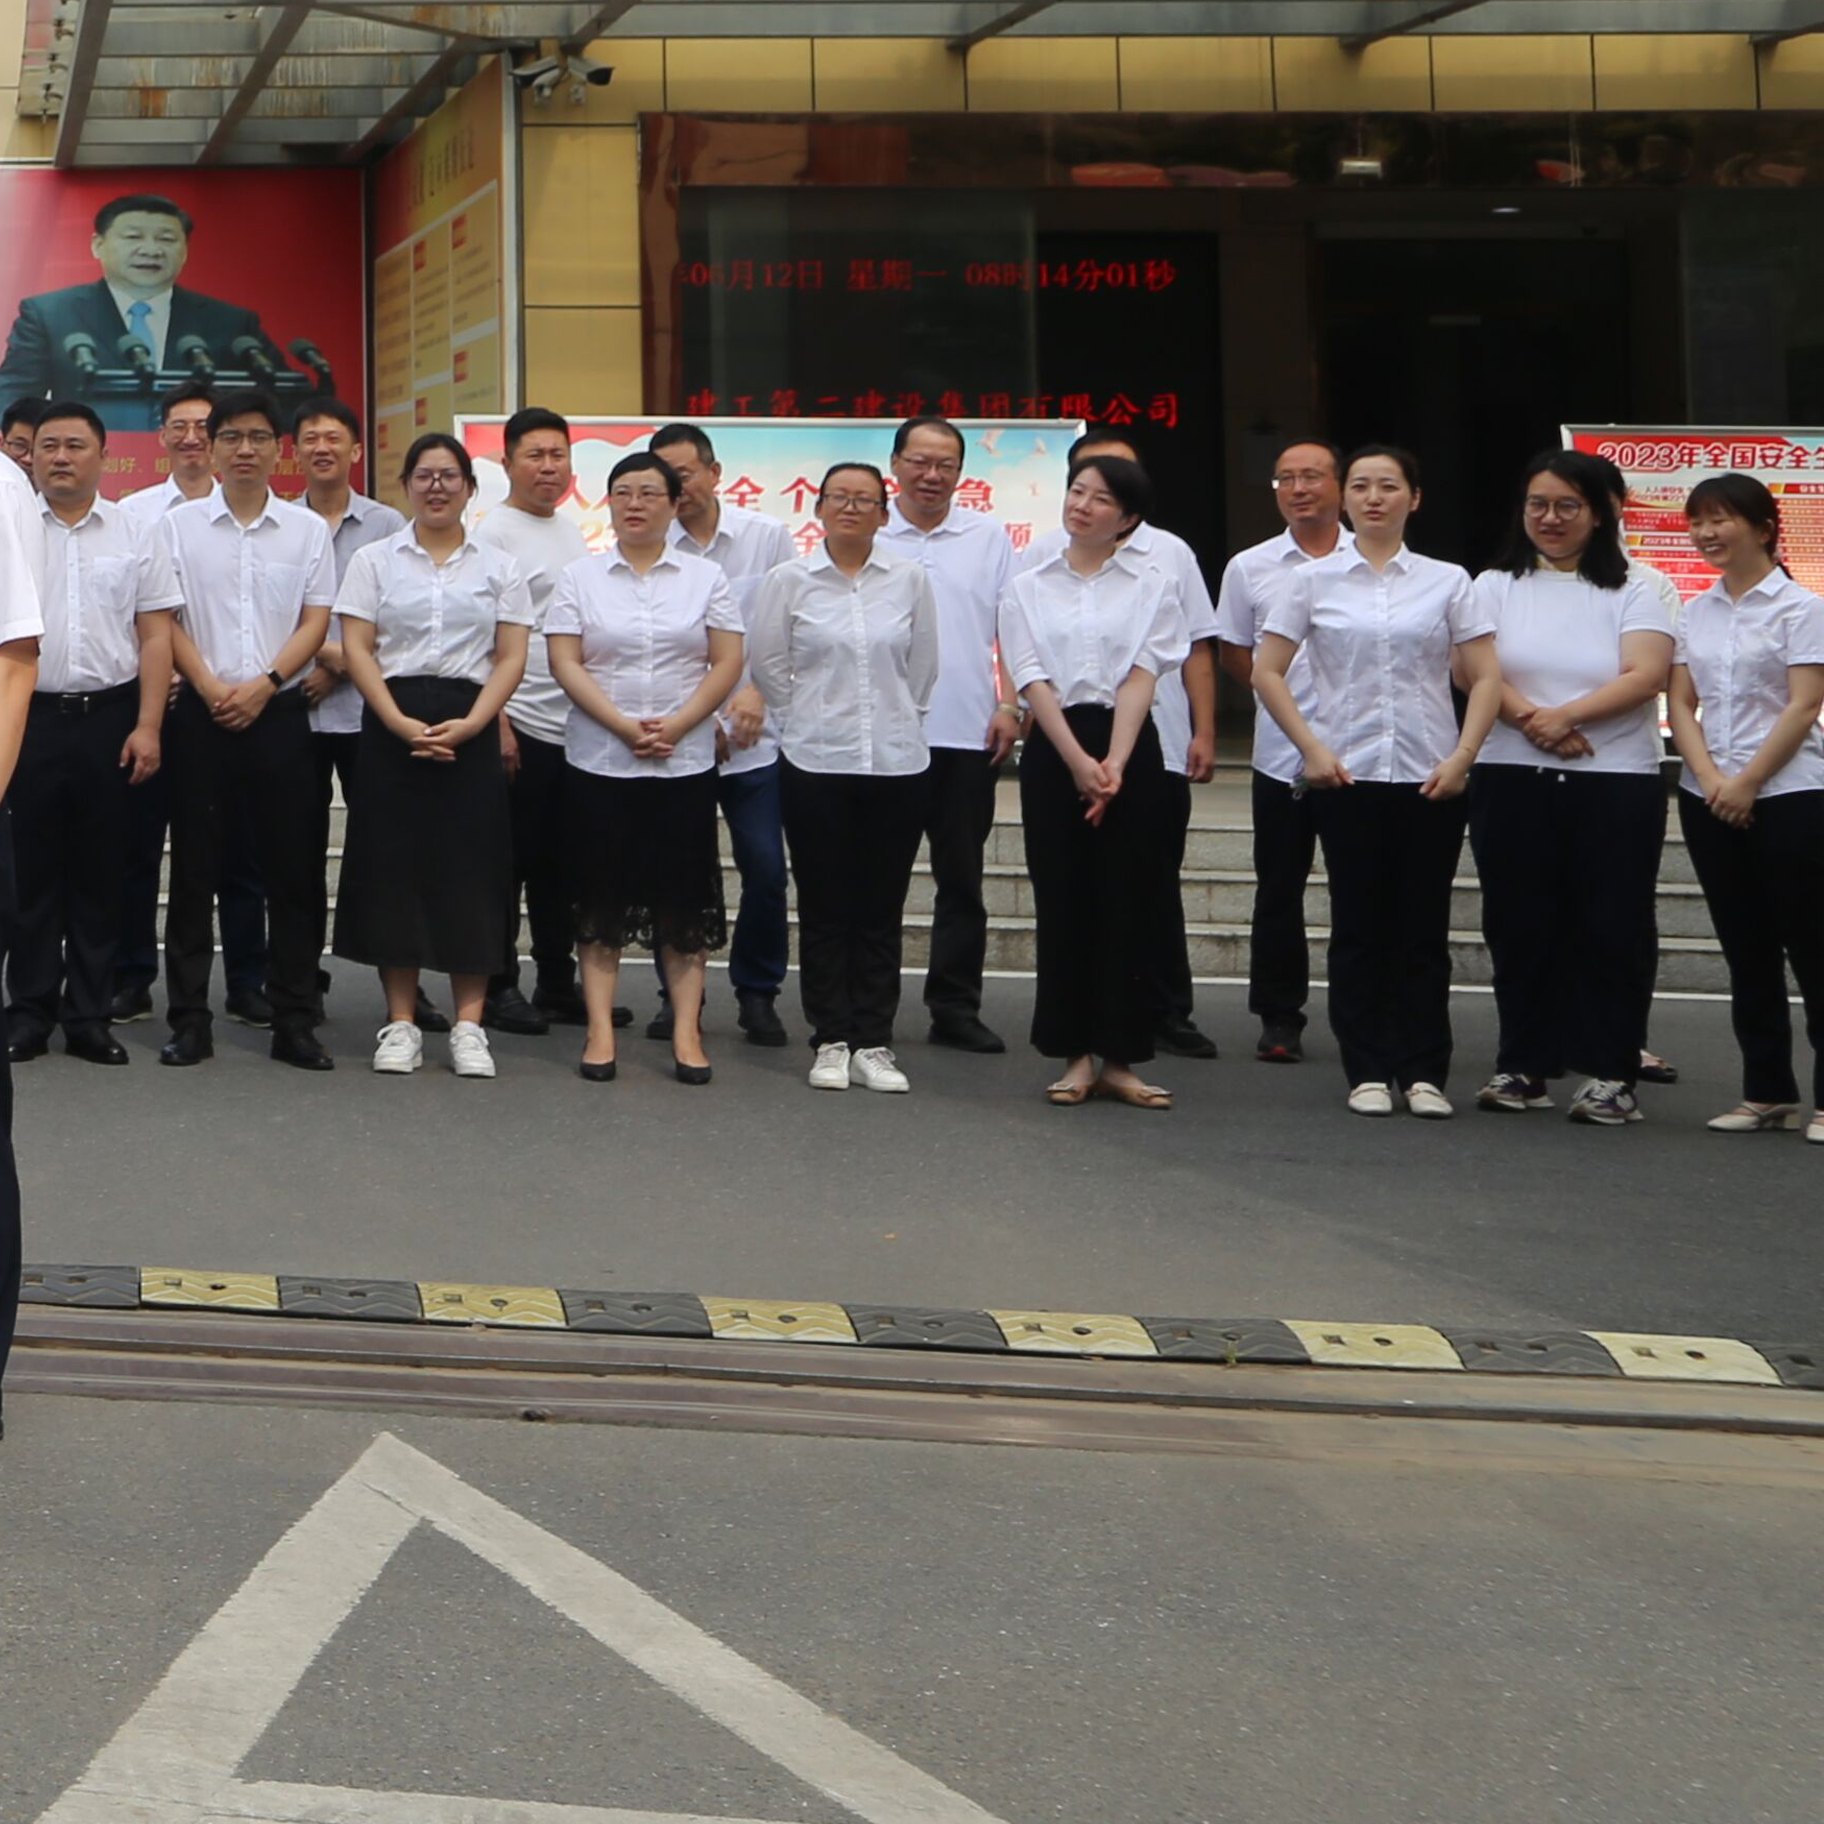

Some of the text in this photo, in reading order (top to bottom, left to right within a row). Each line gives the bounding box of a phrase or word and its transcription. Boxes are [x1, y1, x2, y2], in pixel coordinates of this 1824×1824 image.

[848, 260, 947, 292] 星期一
[966, 260, 1177, 292] 08时14分01秒
